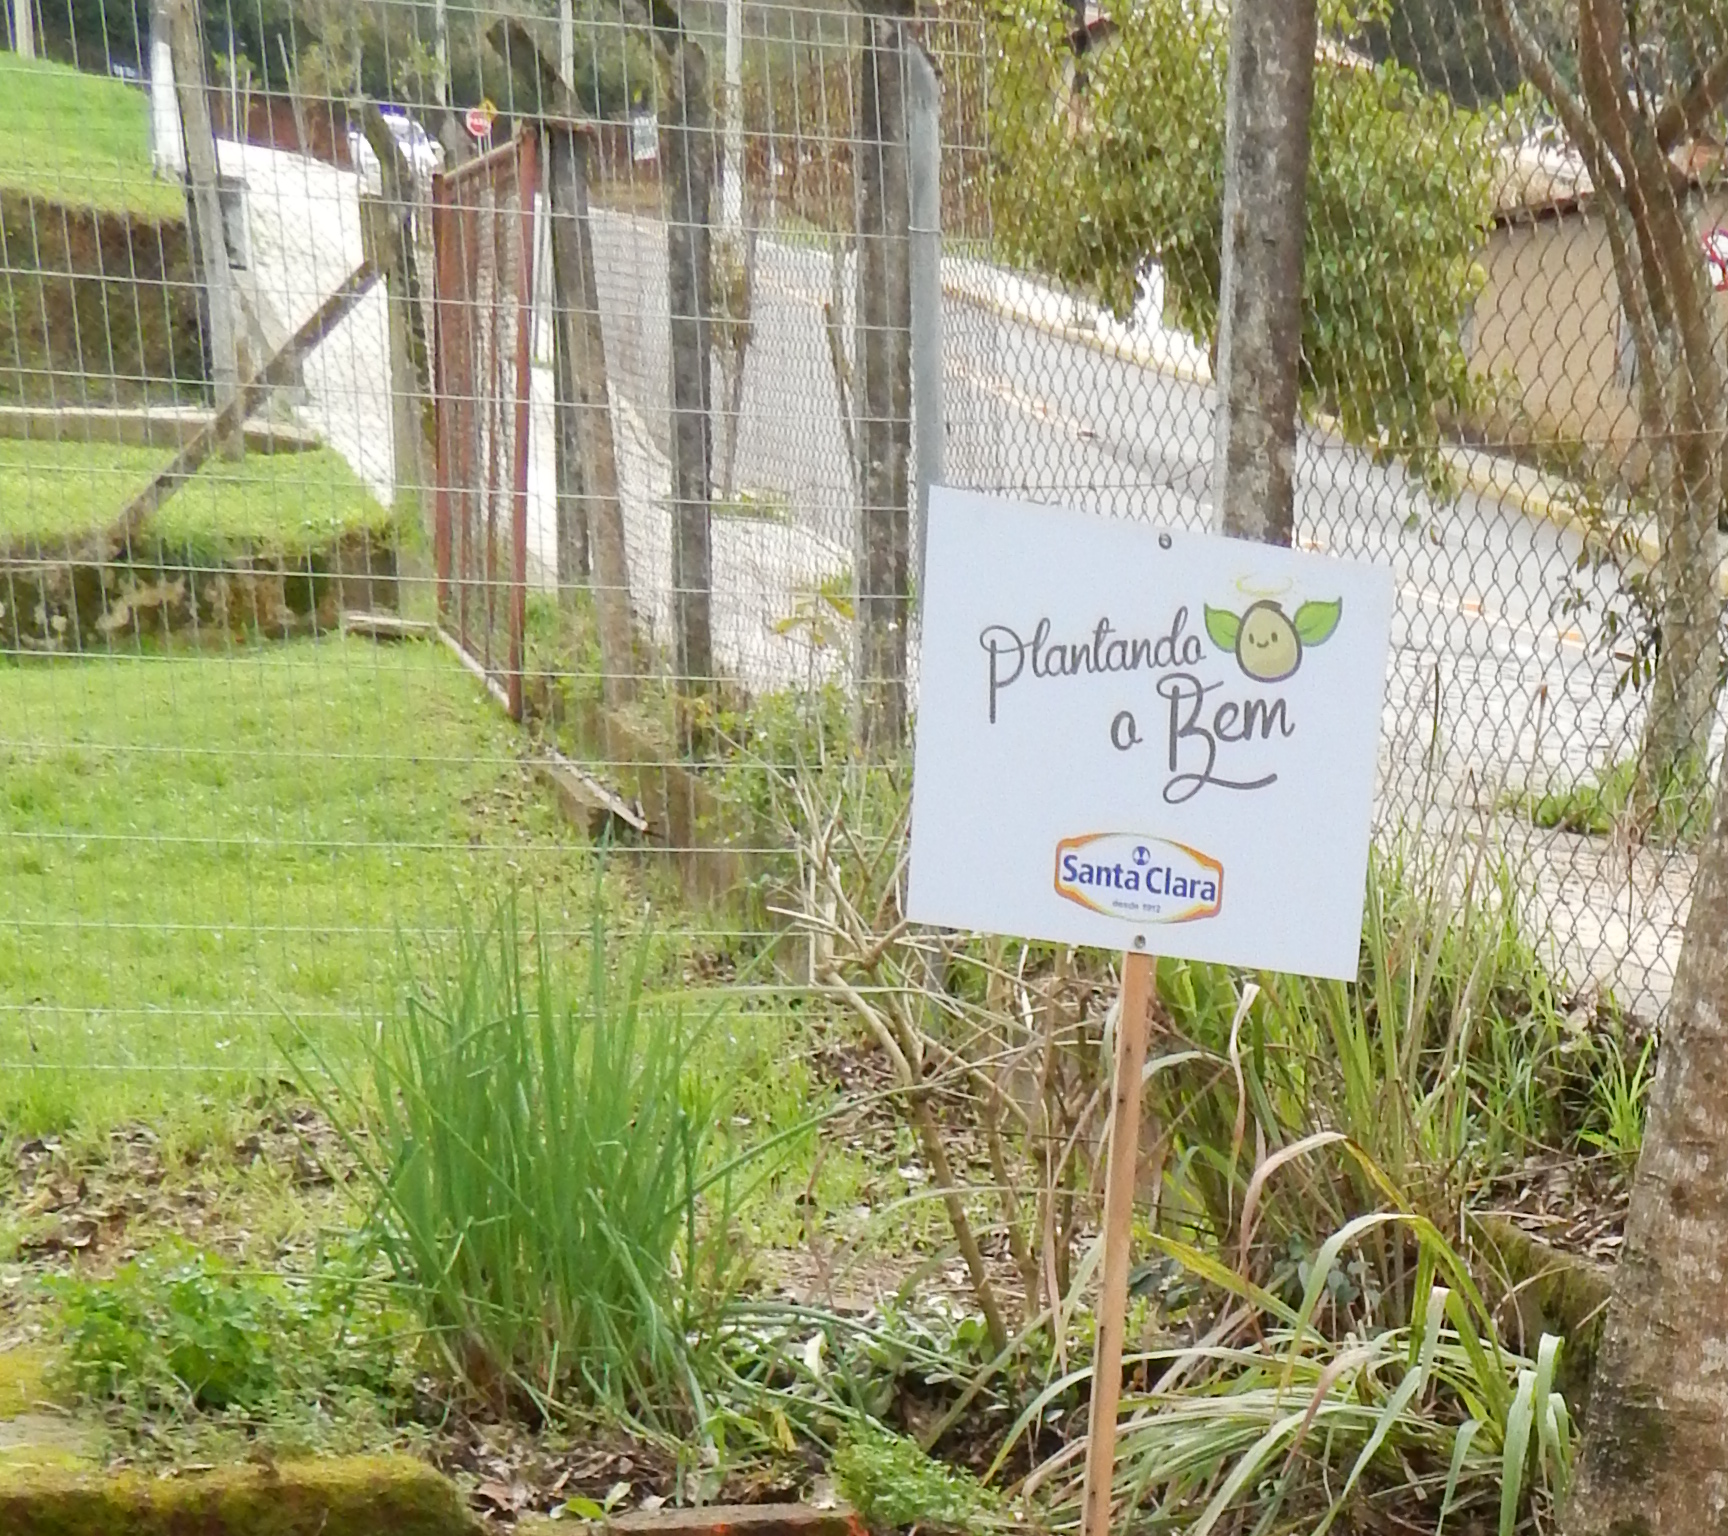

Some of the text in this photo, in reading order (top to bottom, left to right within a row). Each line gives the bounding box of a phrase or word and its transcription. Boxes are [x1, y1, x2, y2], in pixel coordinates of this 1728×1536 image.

[980, 606, 1206, 724] Plantando
[1156, 672, 1295, 804] Bem
[1062, 854, 1216, 902] Santa Clara
